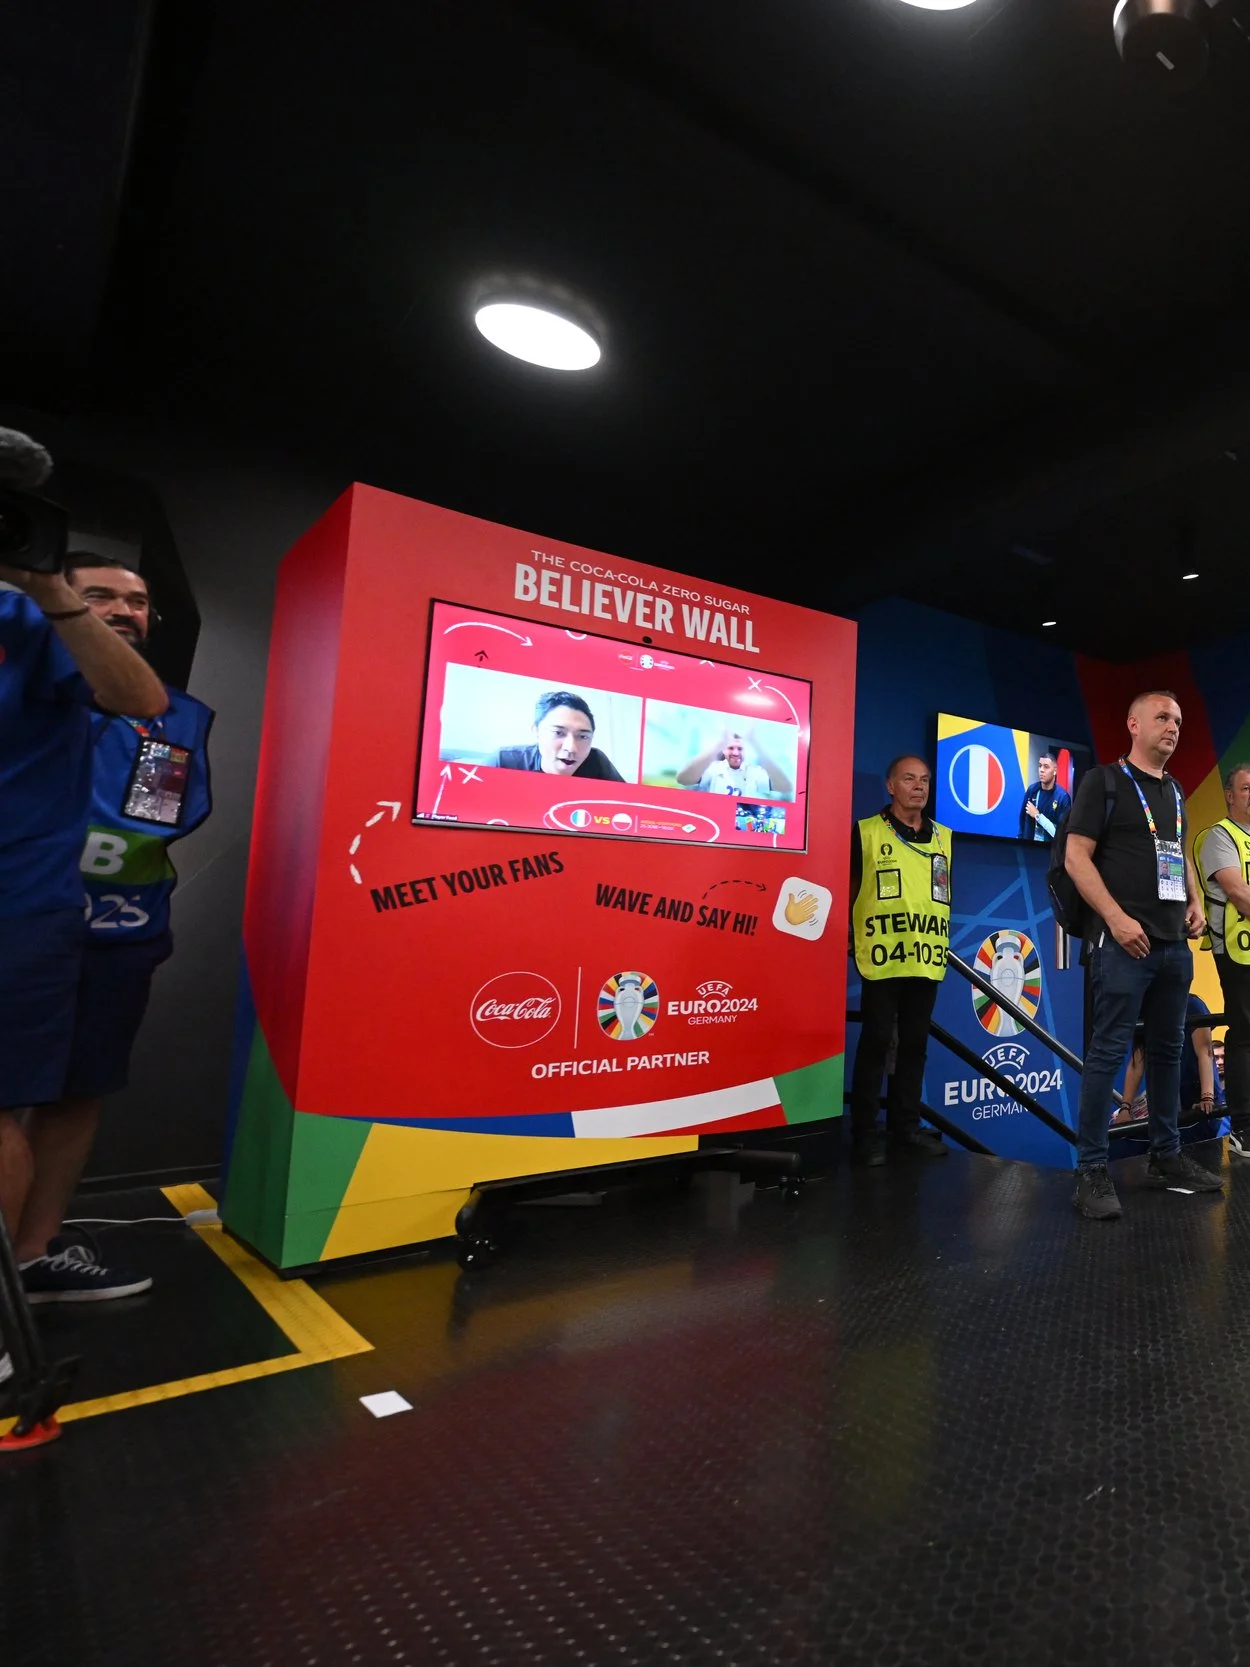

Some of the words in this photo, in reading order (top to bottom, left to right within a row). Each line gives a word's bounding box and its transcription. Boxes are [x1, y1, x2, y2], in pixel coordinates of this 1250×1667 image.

[531, 550, 565, 568] THE
[570, 561, 659, 592] COCA-COLA
[662, 584, 701, 602] ZERO
[704, 595, 750, 615] SUGAR
[514, 562, 674, 634] BELIEVER
[681, 604, 760, 653] WALL
[593, 815, 610, 825] VS
[370, 877, 438, 913] MEET
[440, 863, 508, 897] YOUR
[508, 851, 564, 882] FANS
[84, 892, 149, 929] 25
[595, 883, 653, 915] WAVE
[653, 897, 694, 923] AND
[696, 905, 731, 930] SAY
[732, 913, 758, 936] HI!
[865, 912, 950, 937] STEWAR
[697, 982, 730, 997] UEFA
[476, 997, 556, 1021] Coca-Cola
[667, 998, 758, 1016] EURO2024
[687, 1015, 738, 1026] GERMANY
[531, 1057, 623, 1079] OFFICIAL
[627, 1051, 710, 1072] PARTNER
[984, 1048, 1026, 1068] UEFA
